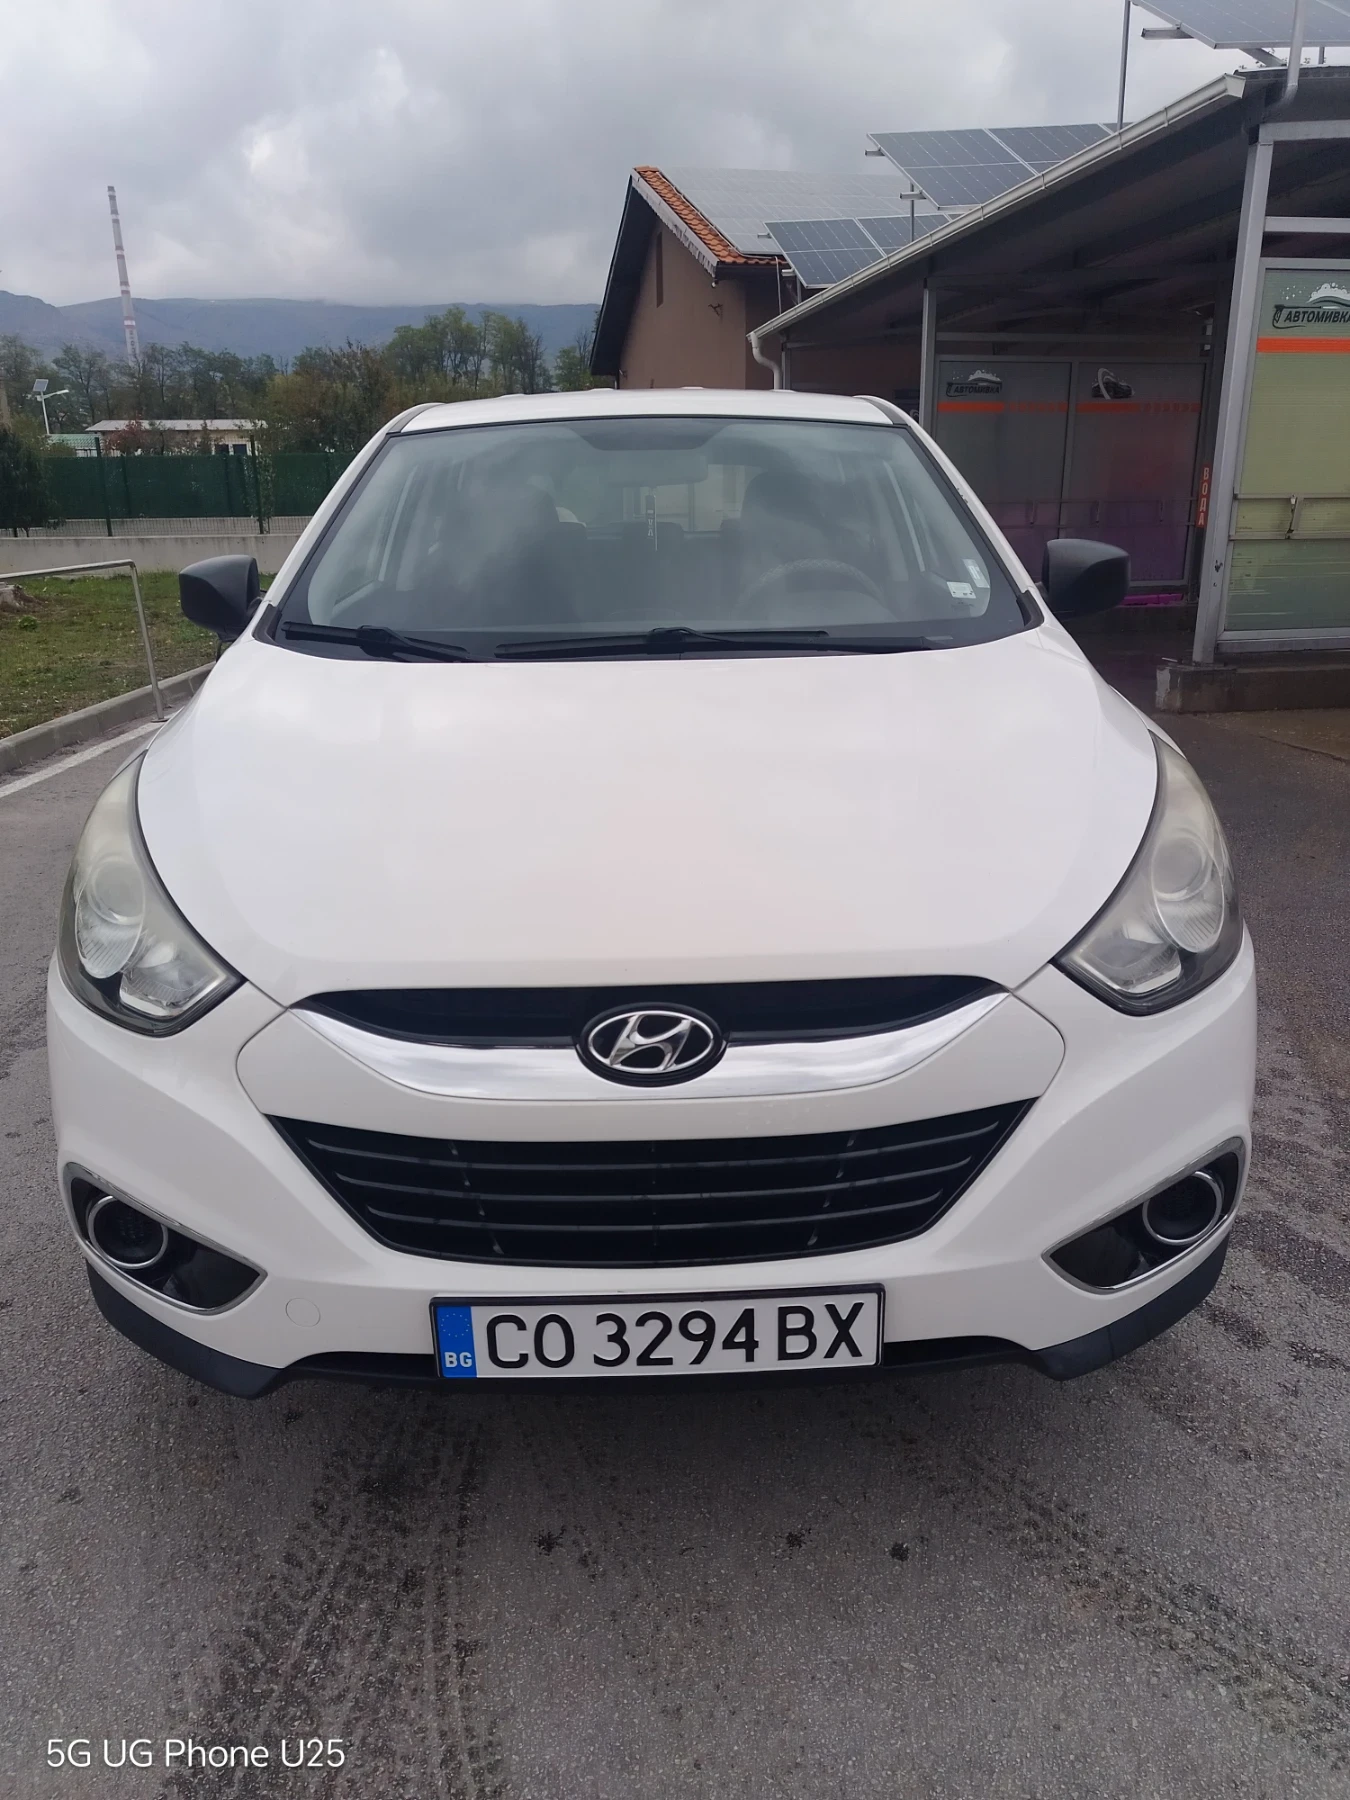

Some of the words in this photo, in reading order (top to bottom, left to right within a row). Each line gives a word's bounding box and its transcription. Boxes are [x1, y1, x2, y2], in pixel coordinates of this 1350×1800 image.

[486, 1313, 575, 1369] CO
[593, 1308, 759, 1367] 3294
[776, 1302, 865, 1361] BX
[444, 1351, 473, 1368] BG
